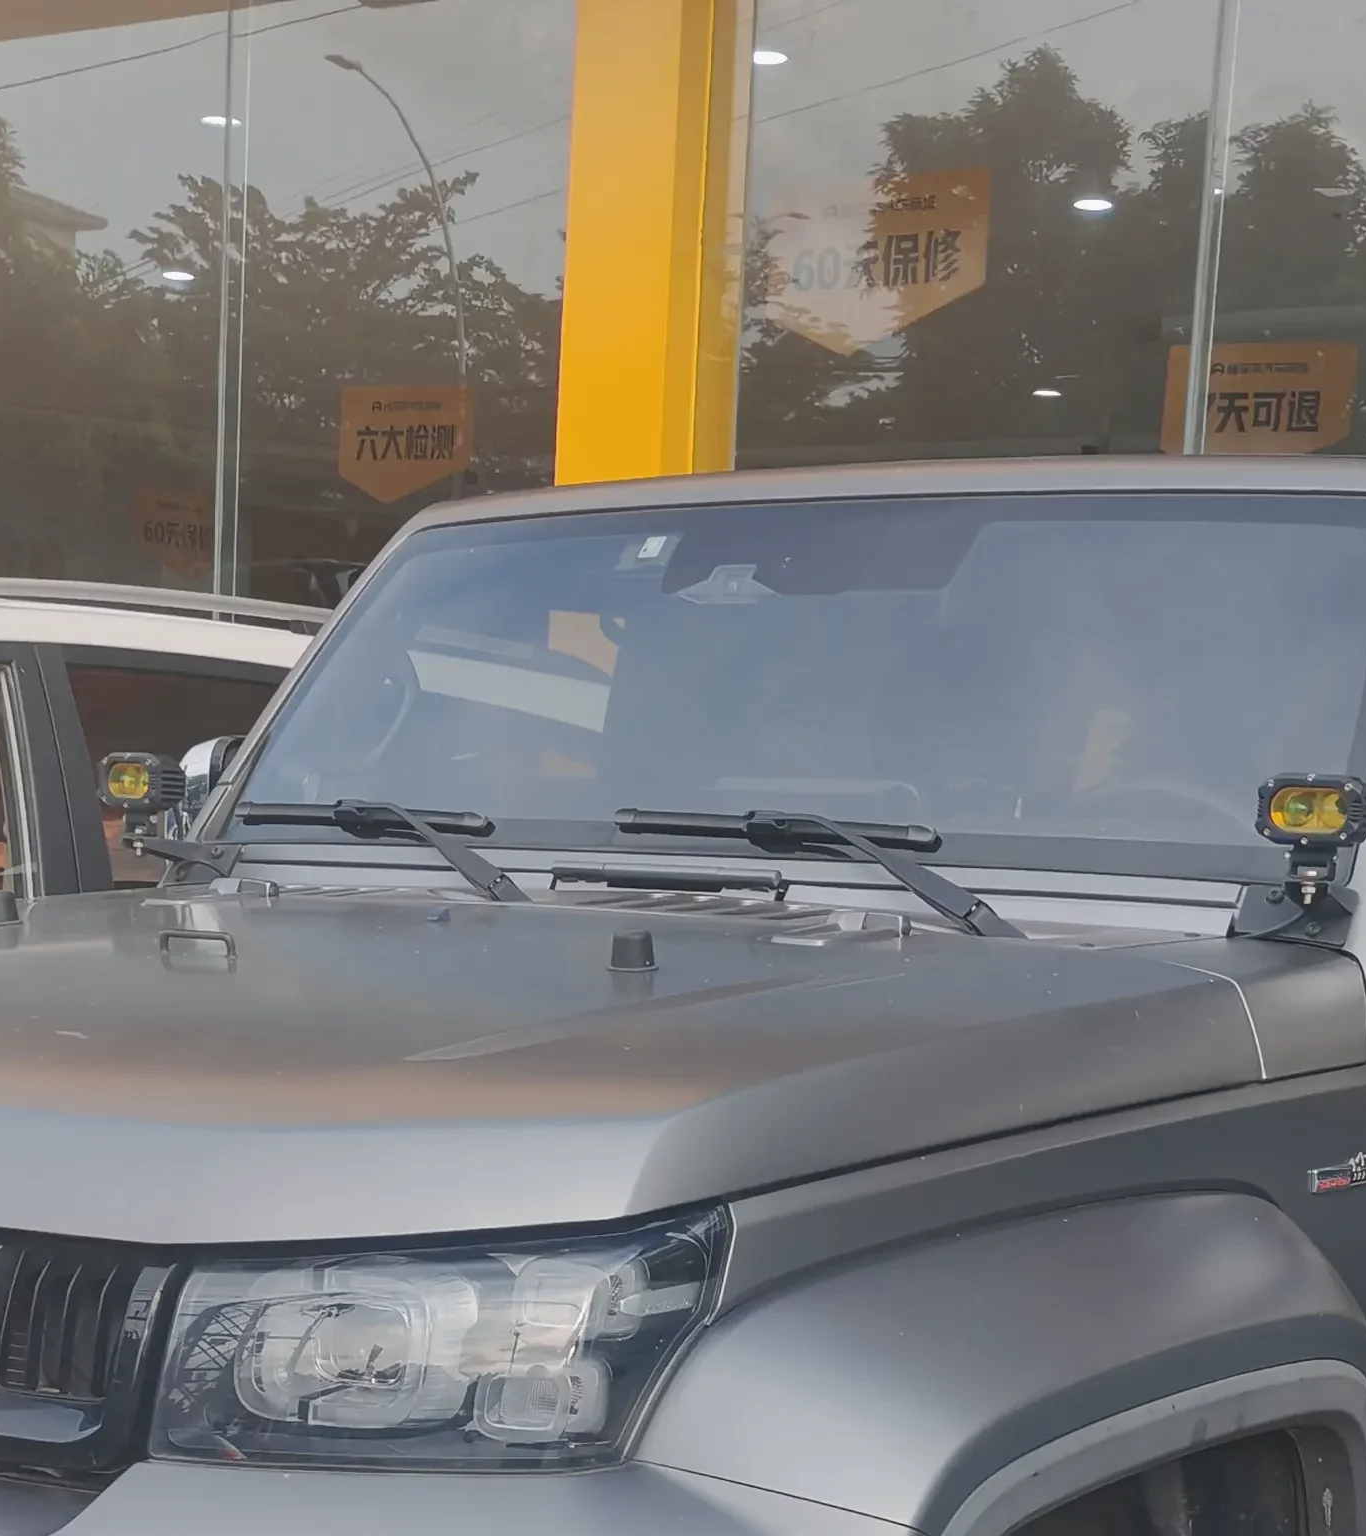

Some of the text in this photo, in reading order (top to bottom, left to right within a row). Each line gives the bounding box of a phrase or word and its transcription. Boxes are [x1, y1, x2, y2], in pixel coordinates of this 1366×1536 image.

[792, 228, 962, 292] 60天保修
[355, 424, 455, 461] 六大检测
